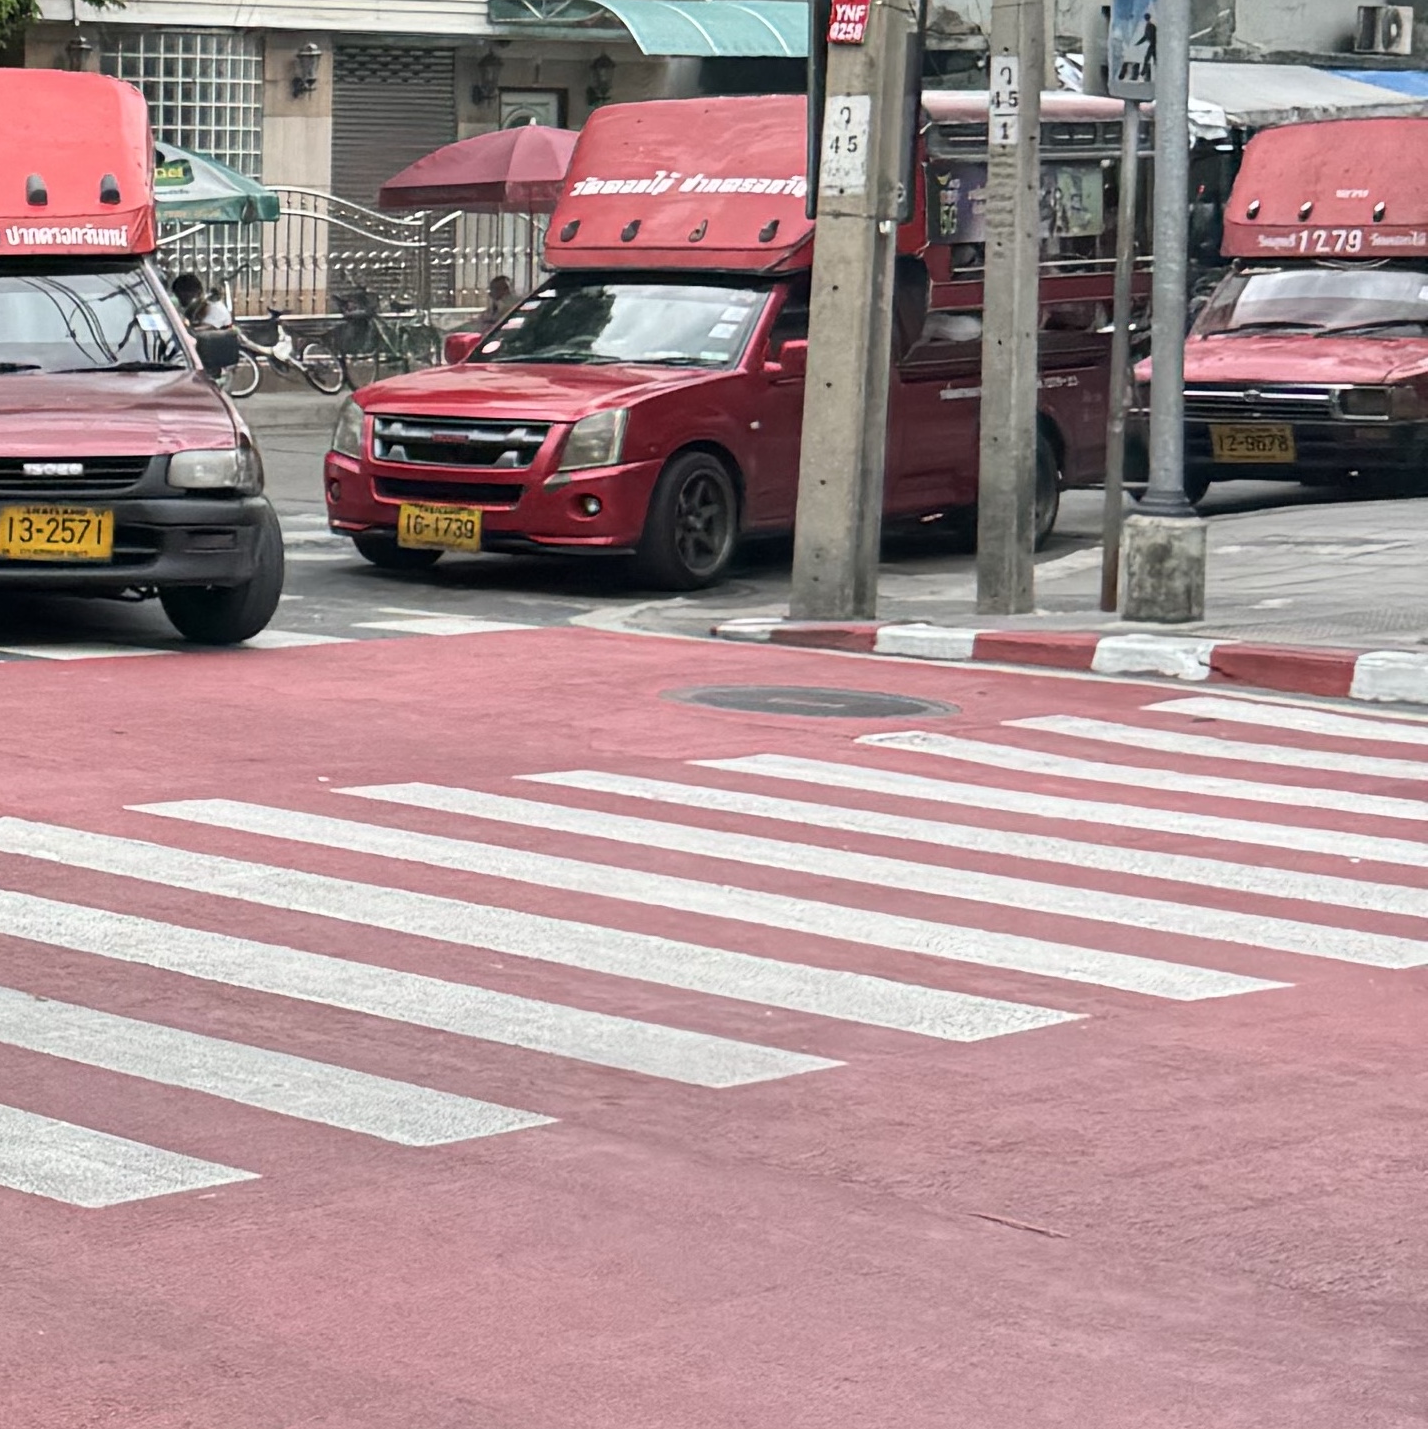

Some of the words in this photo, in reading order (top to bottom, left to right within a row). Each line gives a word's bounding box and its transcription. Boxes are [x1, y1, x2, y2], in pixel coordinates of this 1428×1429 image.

[836, 4, 866, 22] YNF
[1299, 229, 1362, 253] 1279
[8, 516, 102, 545] 13-2571
[406, 513, 475, 540] 16-1739
